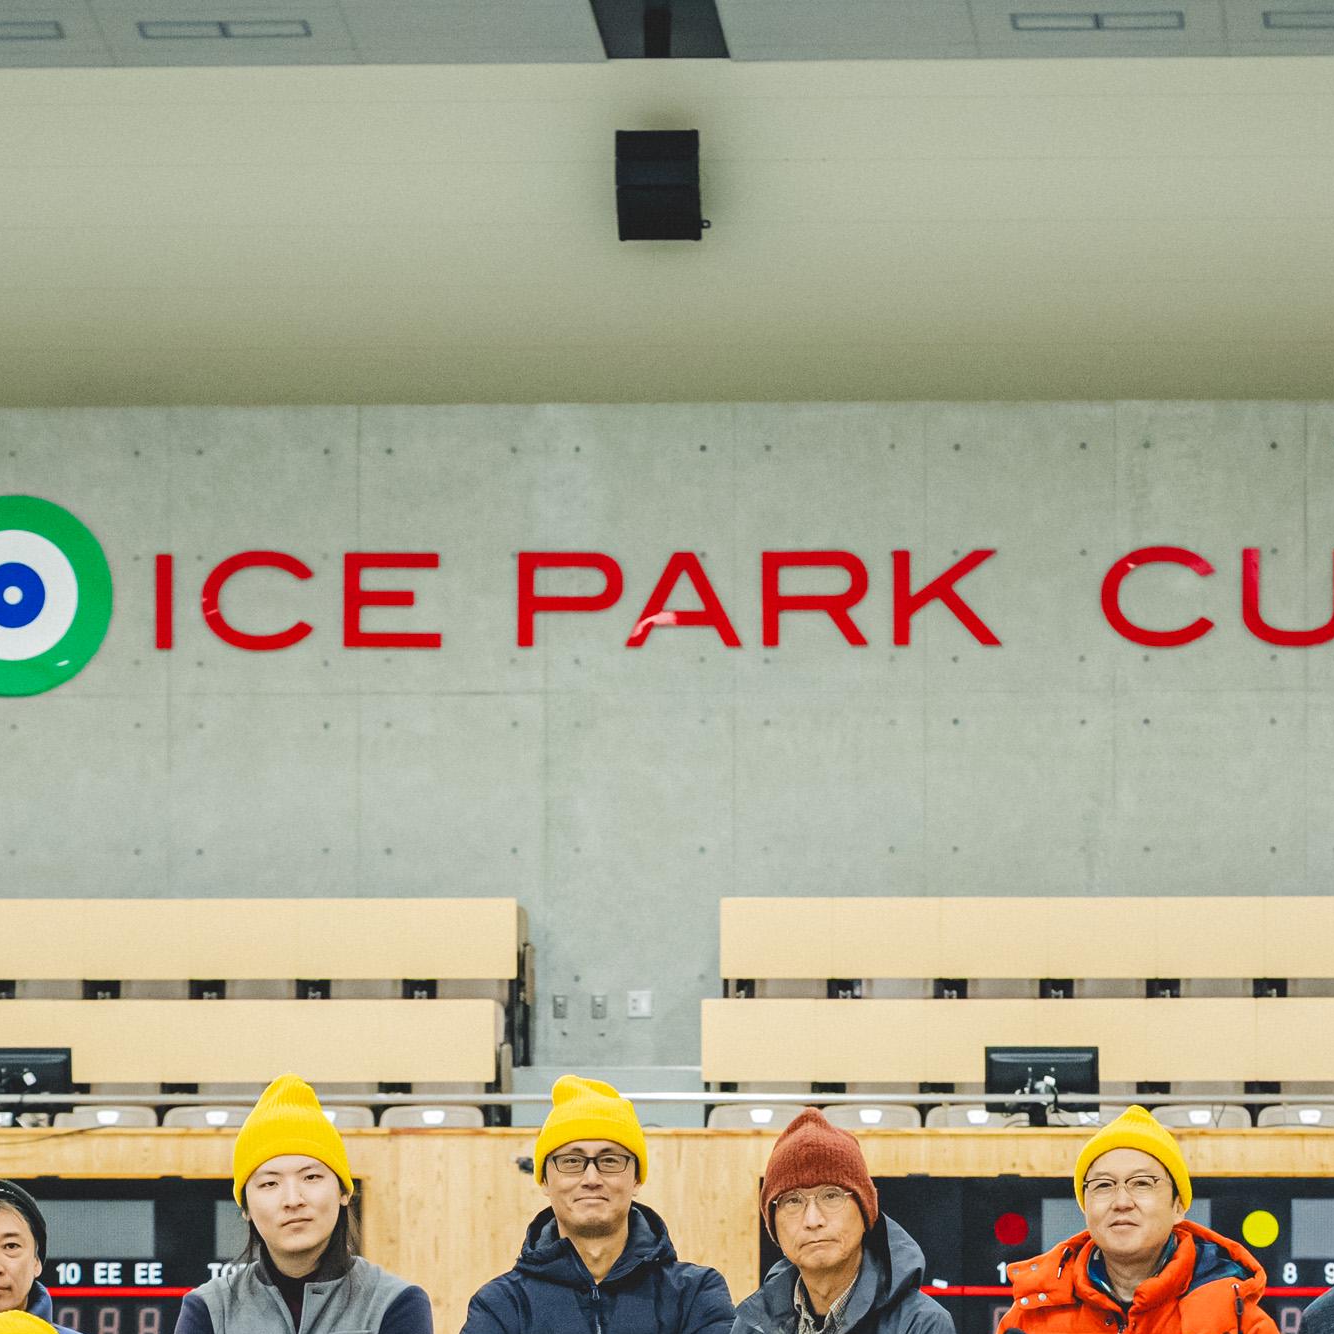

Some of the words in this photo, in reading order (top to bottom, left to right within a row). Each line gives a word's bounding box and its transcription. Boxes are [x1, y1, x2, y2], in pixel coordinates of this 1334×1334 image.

[154, 549, 444, 652] ICE
[516, 548, 1002, 649] PARK
[55, 1262, 81, 1285] 10
[93, 1262, 122, 1285] EE
[134, 1262, 163, 1285] EE
[996, 1262, 1008, 1284] 1
[1282, 1262, 1298, 1285] 8
